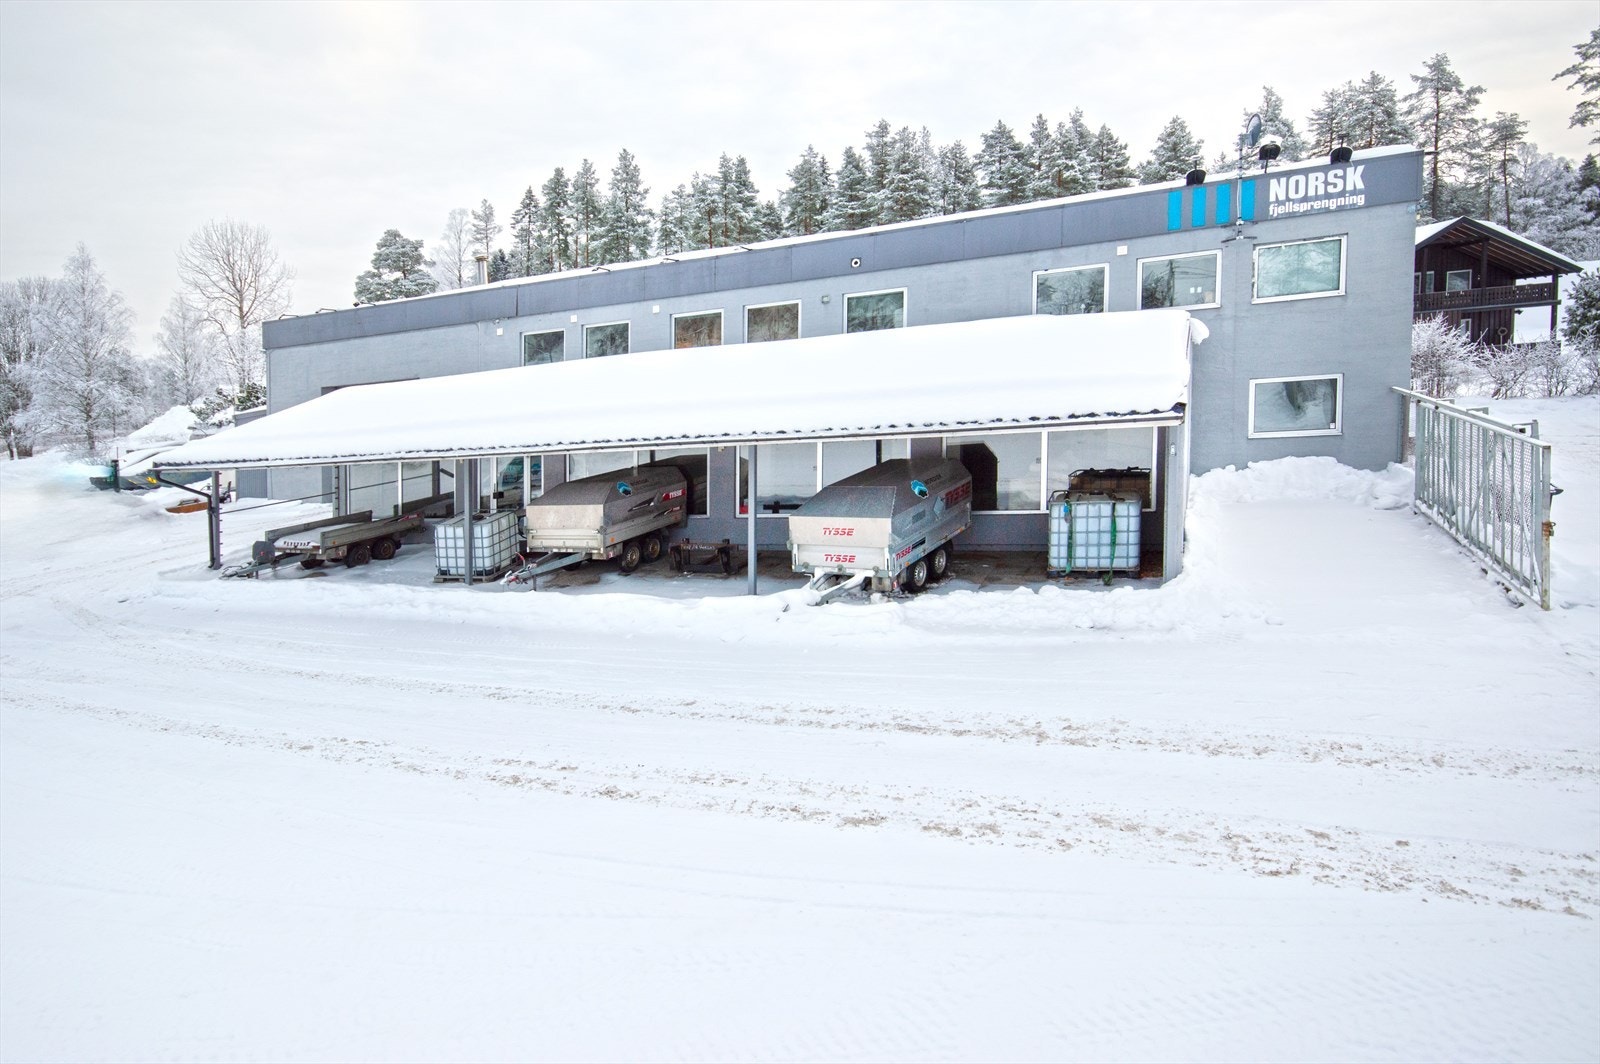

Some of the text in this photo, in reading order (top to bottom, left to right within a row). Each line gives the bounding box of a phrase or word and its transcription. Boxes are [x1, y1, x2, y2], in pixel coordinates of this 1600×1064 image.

[1269, 165, 1365, 202] NORSK
[1269, 193, 1365, 217] fjellsprengning
[823, 527, 854, 536] TYSSE
[824, 553, 856, 563] TYSSE
[896, 545, 911, 561] TYSSE
